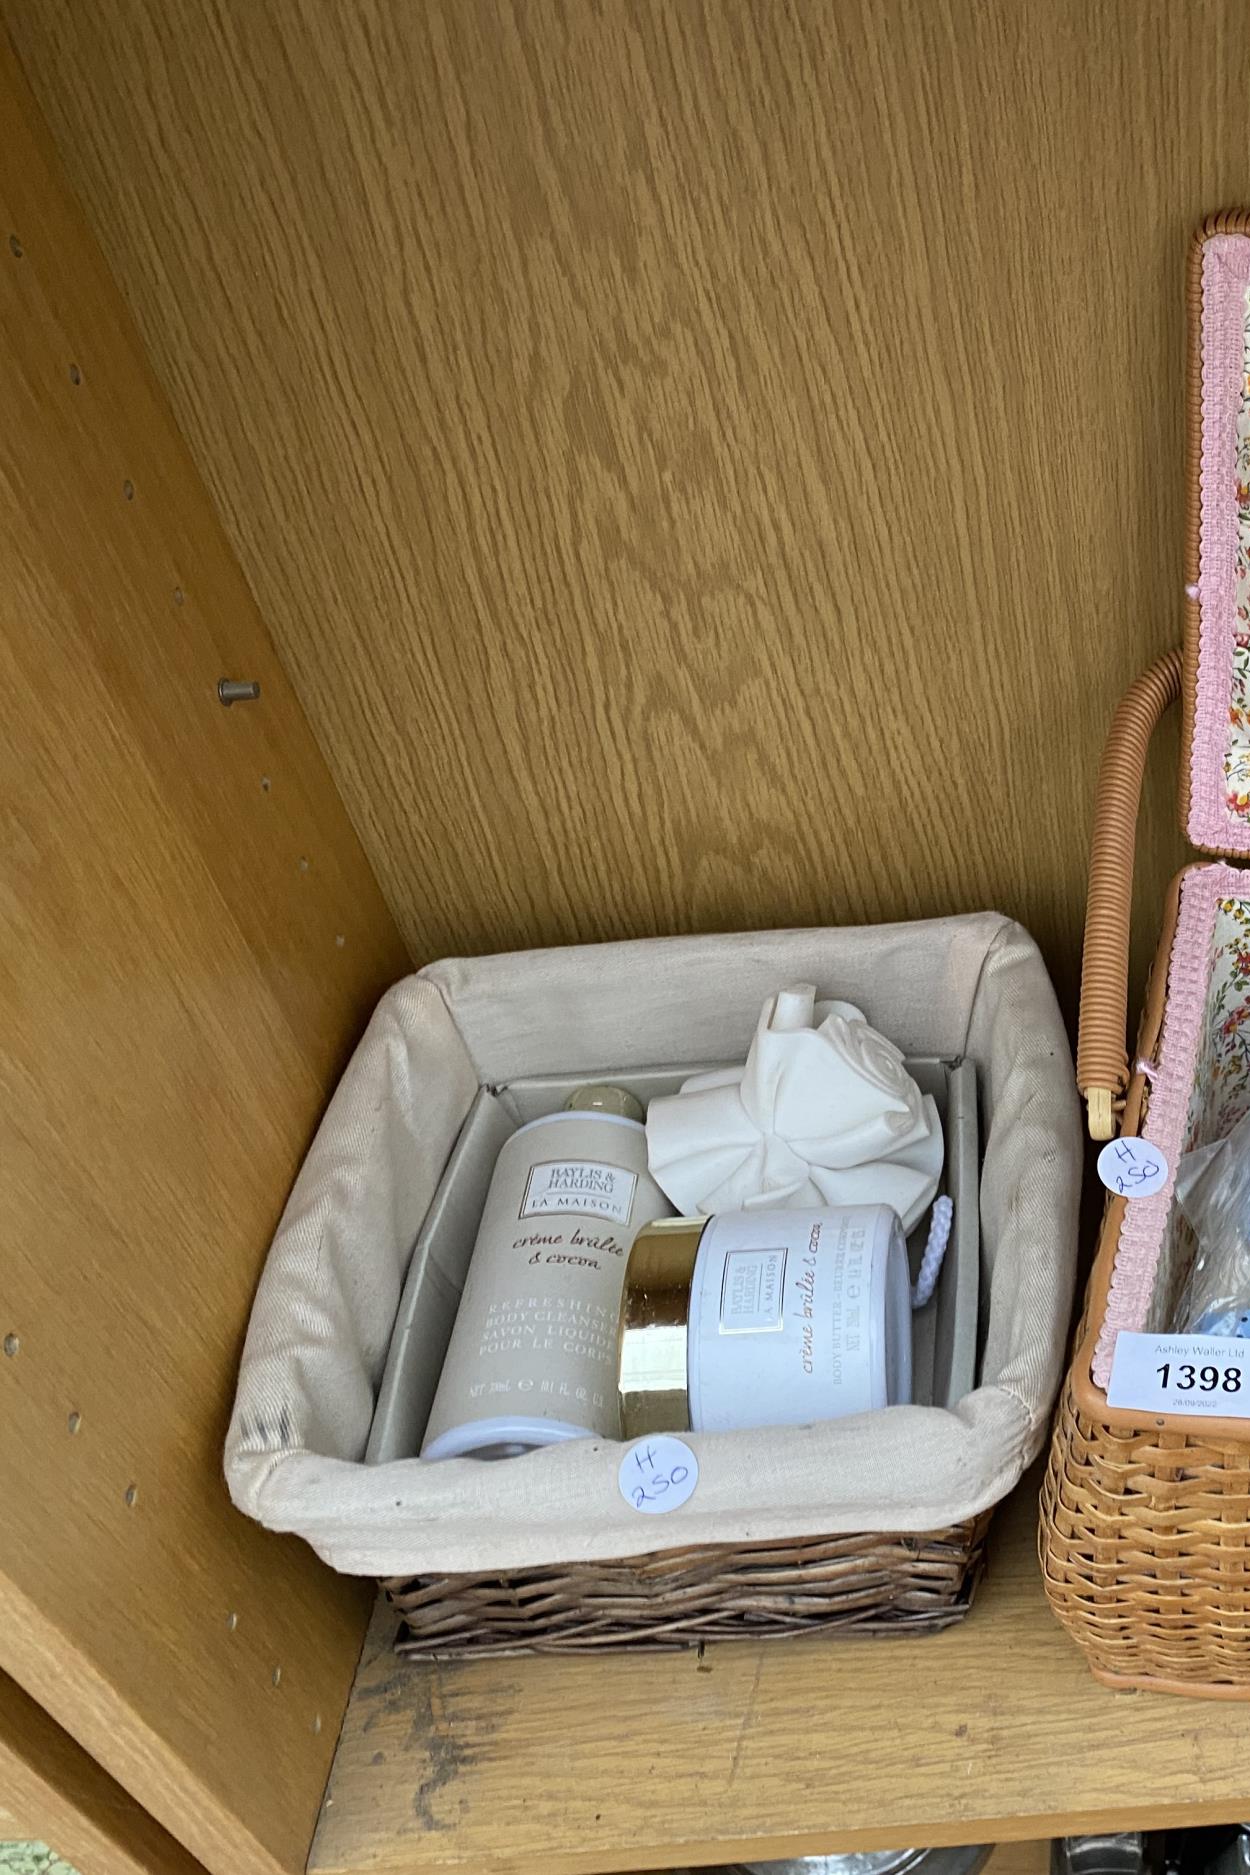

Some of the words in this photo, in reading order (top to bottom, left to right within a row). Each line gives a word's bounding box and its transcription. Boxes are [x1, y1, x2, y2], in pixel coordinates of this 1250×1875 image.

[1114, 1140, 1136, 1163] H
[548, 1179, 614, 1193] HARDING
[551, 1167, 602, 1180] BAYLIS
[605, 1172, 616, 1182] &
[532, 1199, 548, 1208] LA
[557, 1198, 622, 1213] MAISON
[546, 1253, 601, 1270] cocoa
[765, 1254, 778, 1301] MAISON
[482, 1325, 537, 1341] SAVON
[547, 1325, 612, 1349] LIQUIDE
[486, 1311, 529, 1328] BODY
[534, 1311, 616, 1336] CLEANSER
[832, 1301, 843, 1349] BUTTER
[479, 1338, 523, 1356] POUR
[533, 1336, 553, 1349] LE
[563, 1341, 612, 1365] CORPS
[800, 1324, 813, 1374] crème
[1155, 1344, 1190, 1357] Ashley
[1192, 1346, 1226, 1357] Waller
[1228, 1348, 1245, 1358] Ltd
[832, 1351, 843, 1385] BODY
[1156, 1363, 1242, 1393] 1398
[635, 1445, 656, 1474] H
[632, 1466, 688, 1508] 250
